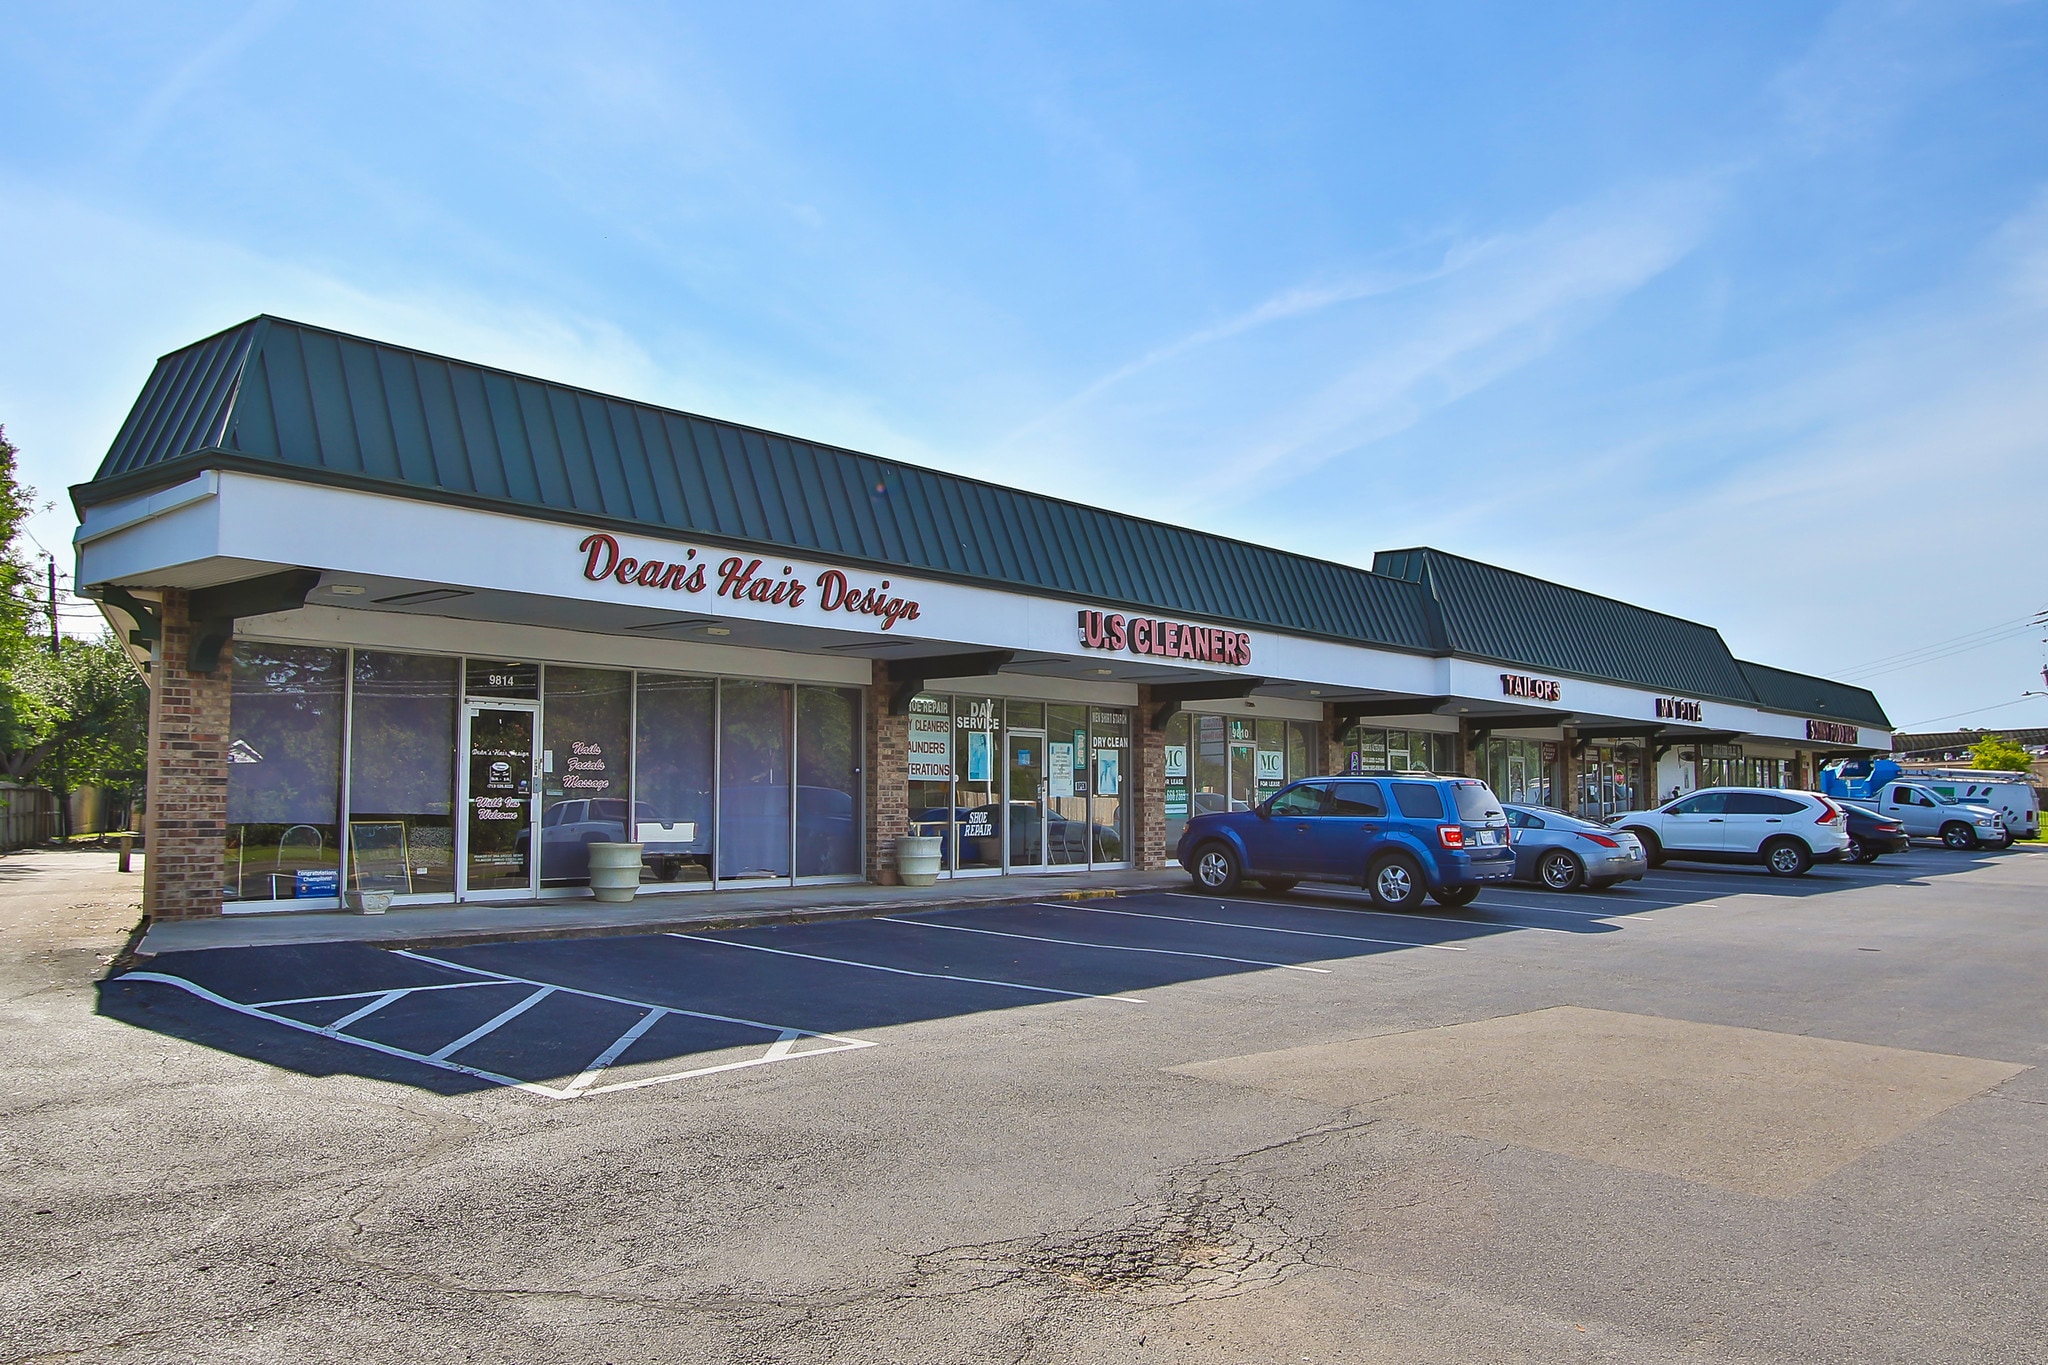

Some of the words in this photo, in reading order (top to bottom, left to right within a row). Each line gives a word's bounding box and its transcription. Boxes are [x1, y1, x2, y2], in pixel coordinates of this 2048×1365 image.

[579, 533, 706, 593] Dean's
[717, 557, 807, 609] Hair
[817, 569, 921, 631] Design
[1127, 618, 1252, 667] CLEANERS
[489, 674, 514, 686] 9814
[1500, 674, 1560, 702] TAILORS
[923, 701, 948, 714] REPAIR
[970, 702, 994, 718] DAY
[915, 719, 949, 733] CLEANERS
[957, 716, 1000, 730] SERVICE
[1232, 728, 1249, 738] 9810
[572, 741, 601, 755] Nails
[908, 740, 946, 754] AUNDERS
[1093, 736, 1107, 748] DRY
[1107, 736, 1129, 748] CLEAN
[567, 756, 606, 772] Facials
[1260, 754, 1280, 771] MC
[562, 775, 610, 791] Massage
[476, 796, 502, 807] Walk
[504, 796, 520, 808] Ins
[478, 809, 518, 820] Welcome
[968, 811, 988, 824] SHOE
[964, 823, 992, 836] REPAIR
